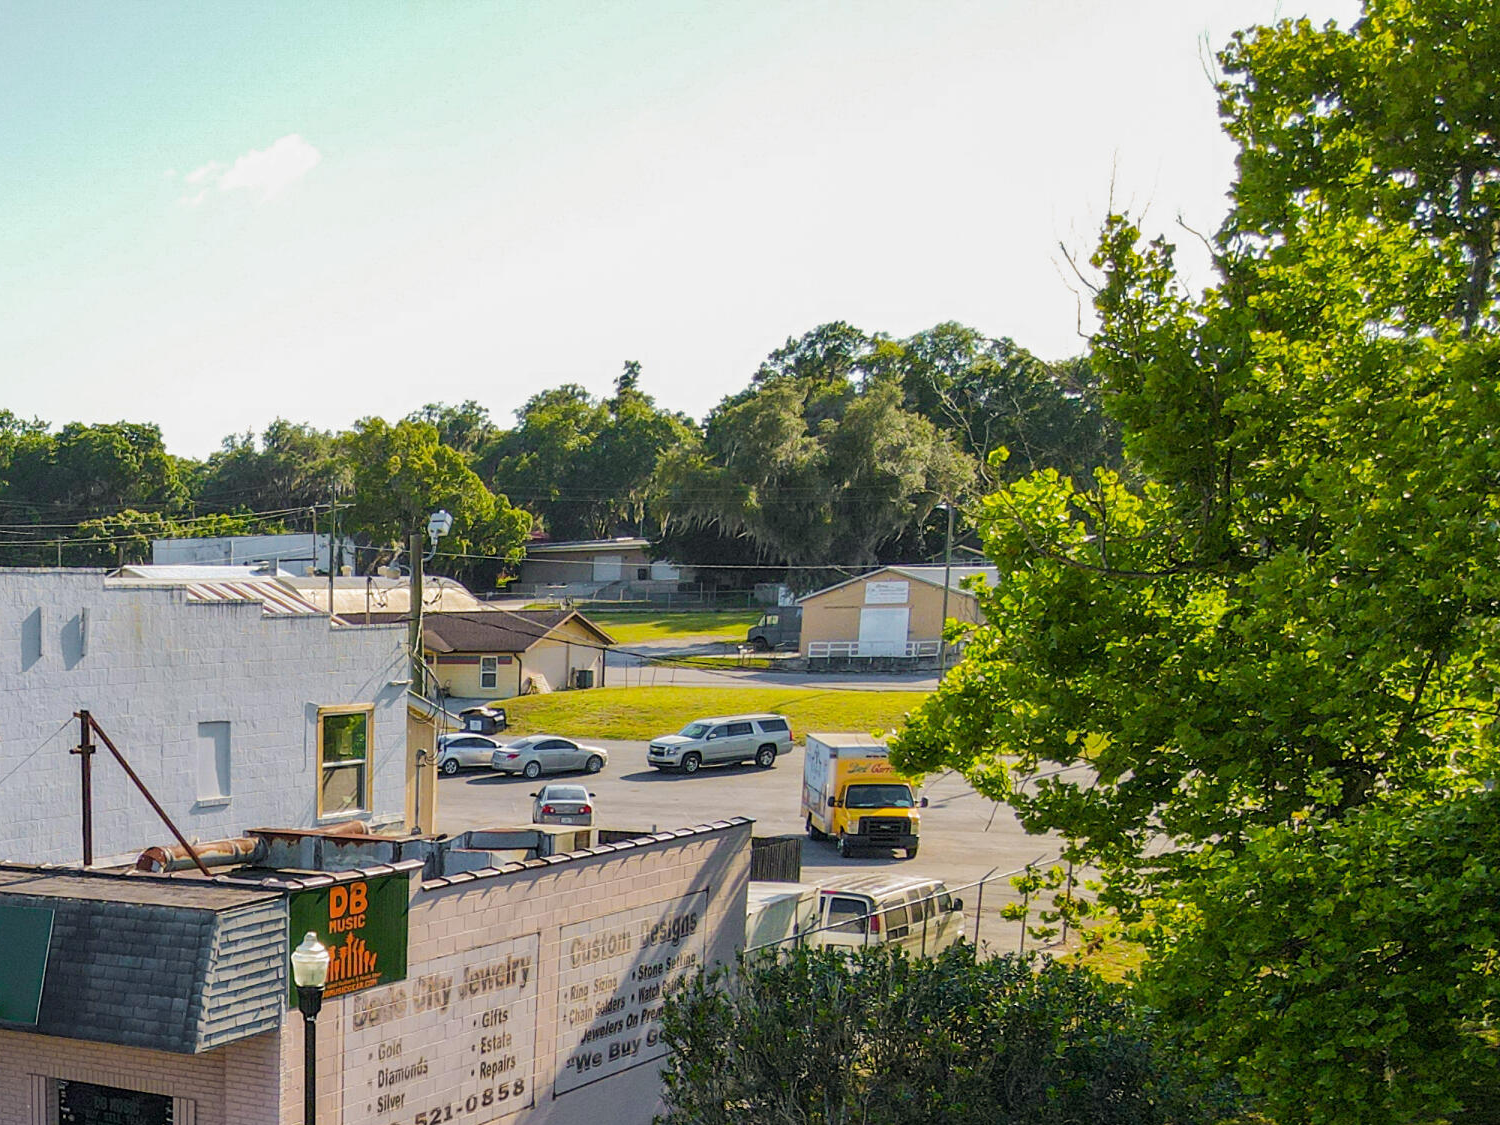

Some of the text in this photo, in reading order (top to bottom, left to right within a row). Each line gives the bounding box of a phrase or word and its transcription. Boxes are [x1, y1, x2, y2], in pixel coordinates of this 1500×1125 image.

[329, 881, 368, 919] DB
[328, 914, 366, 934] MUSIC
[570, 912, 698, 969] Custom Designs
[458, 955, 532, 998] Jewelry
[638, 952, 696, 982] Stone Setting
[570, 976, 618, 1001] Ring Sizing
[638, 984, 660, 1004] Watch
[482, 1009, 508, 1028] Gifts
[569, 996, 626, 1026] Chain Solders
[581, 1004, 664, 1045] Jewelers On Prem
[378, 1039, 402, 1061] Gold
[480, 1032, 512, 1055] Estate
[608, 1037, 642, 1063] Buy
[377, 1057, 428, 1088] Diamonds
[479, 1055, 516, 1080] Repairs
[377, 1092, 405, 1114] Silver
